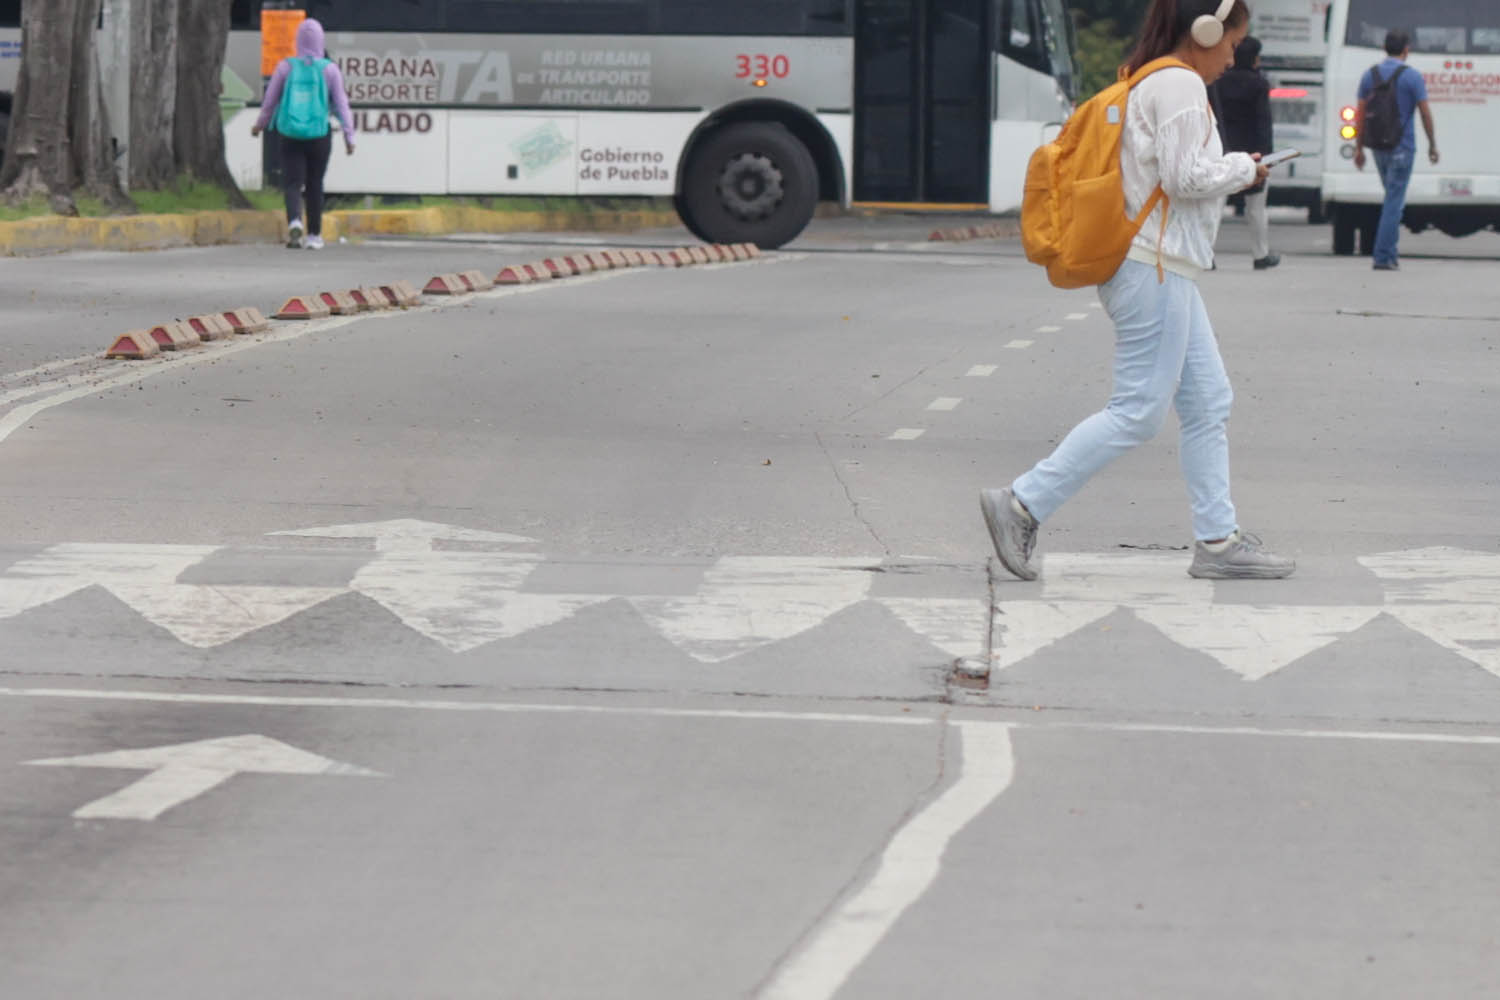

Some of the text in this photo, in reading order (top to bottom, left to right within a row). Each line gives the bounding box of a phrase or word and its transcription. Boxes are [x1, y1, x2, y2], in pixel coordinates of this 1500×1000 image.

[542, 51, 651, 66] RED URBANA
[735, 54, 790, 78] 330
[539, 69, 651, 85] TRANSPORTE
[538, 89, 650, 105] ARTICULADO
[579, 148, 664, 164] Gobierno
[579, 166, 669, 182] de Puebla
